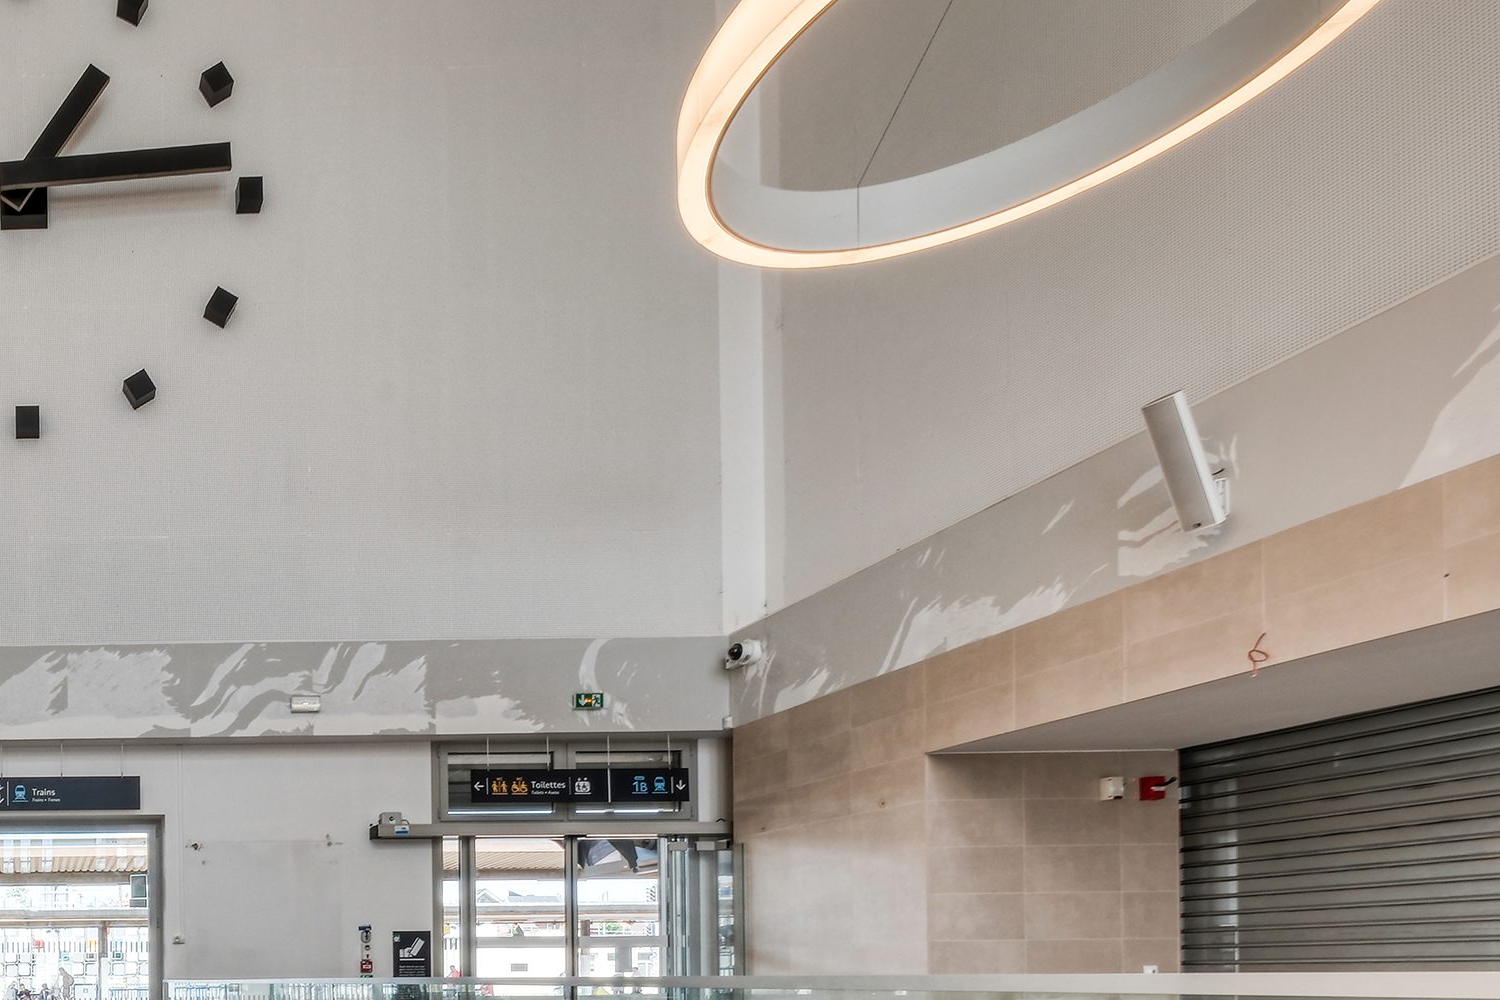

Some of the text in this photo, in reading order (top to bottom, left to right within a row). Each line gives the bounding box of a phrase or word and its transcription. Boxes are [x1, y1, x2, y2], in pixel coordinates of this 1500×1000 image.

[531, 781, 566, 789] Toilettes
[632, 780, 649, 792] 1B
[32, 788, 56, 796] Trains
